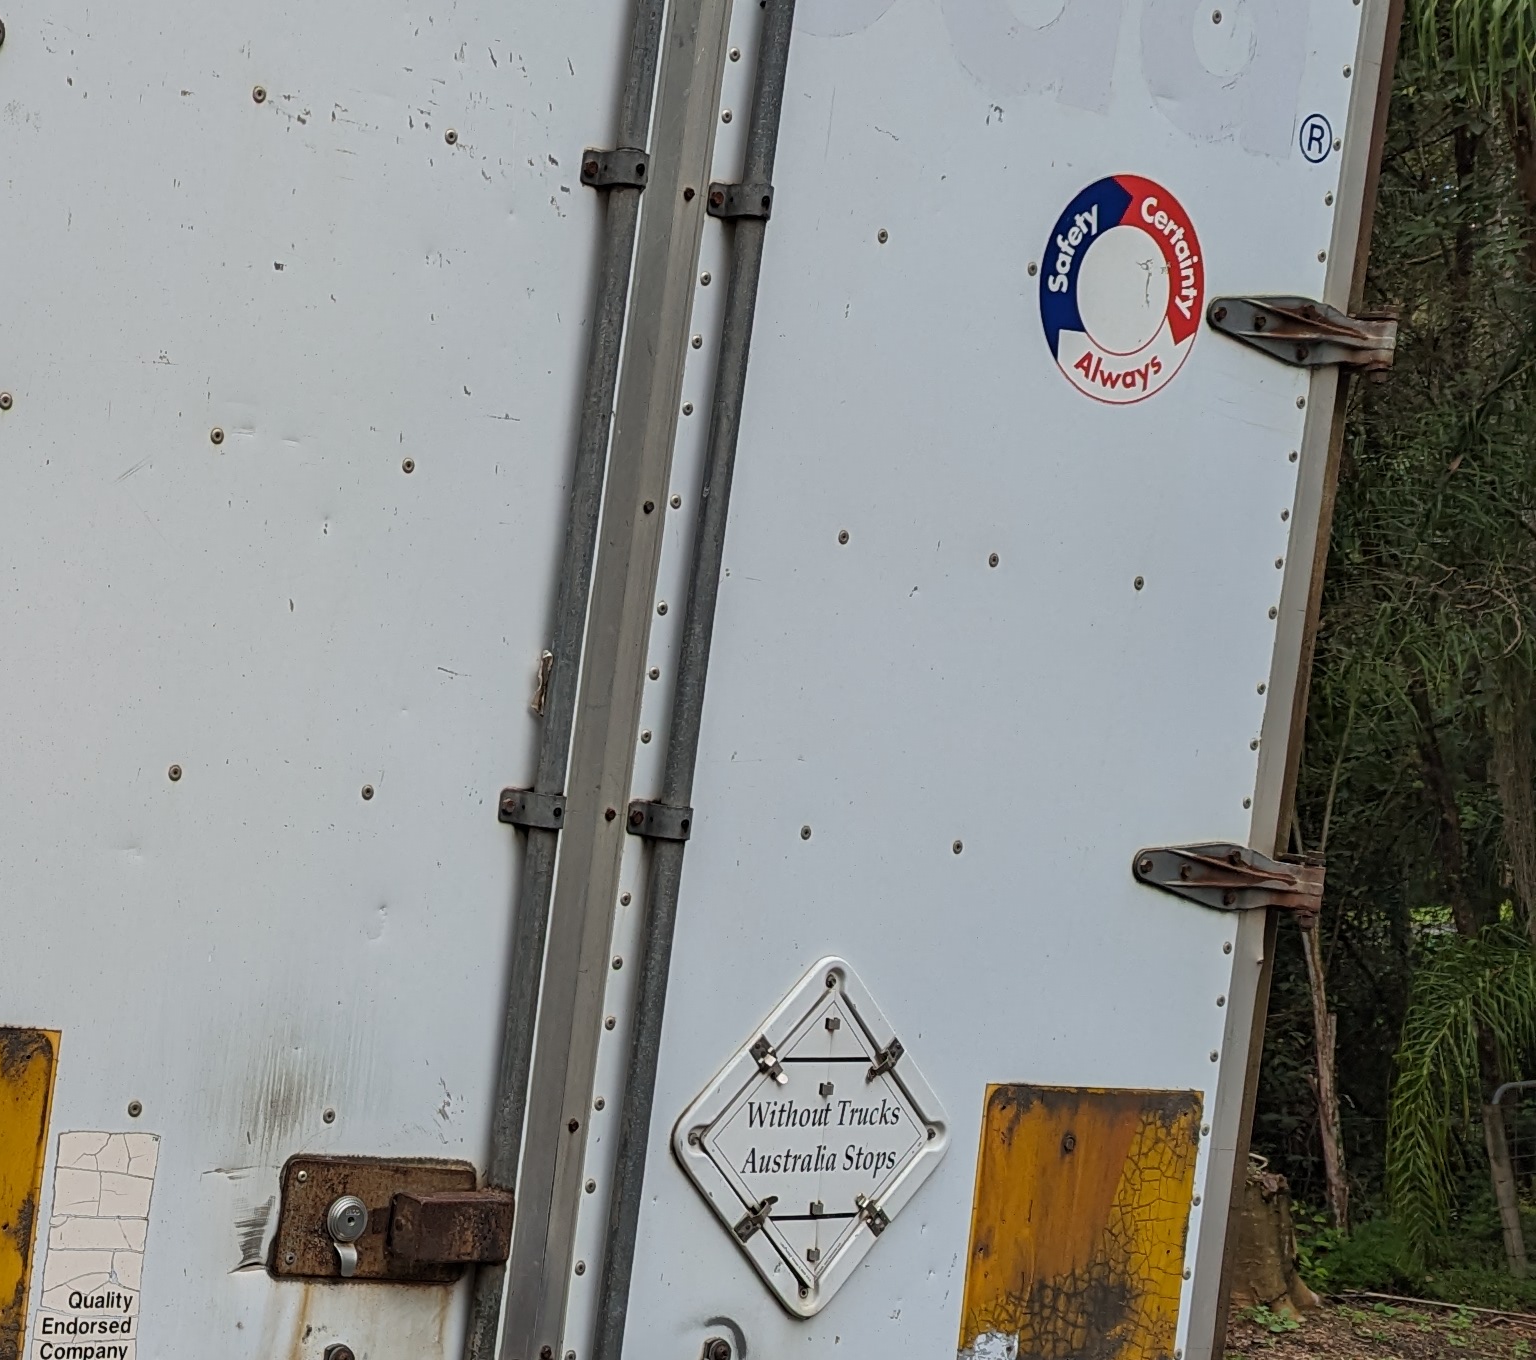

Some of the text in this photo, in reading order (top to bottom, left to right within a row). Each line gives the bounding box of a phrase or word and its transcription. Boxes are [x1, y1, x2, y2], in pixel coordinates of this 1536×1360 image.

[1047, 203, 1099, 293] Safety
[1141, 197, 1198, 320] Certainty
[1074, 351, 1163, 392] Always
[748, 1098, 901, 1128] Without Trucks
[740, 1144, 897, 1179] Australia Stops
[68, 1291, 133, 1313] Quality
[42, 1317, 132, 1335] Endorsed
